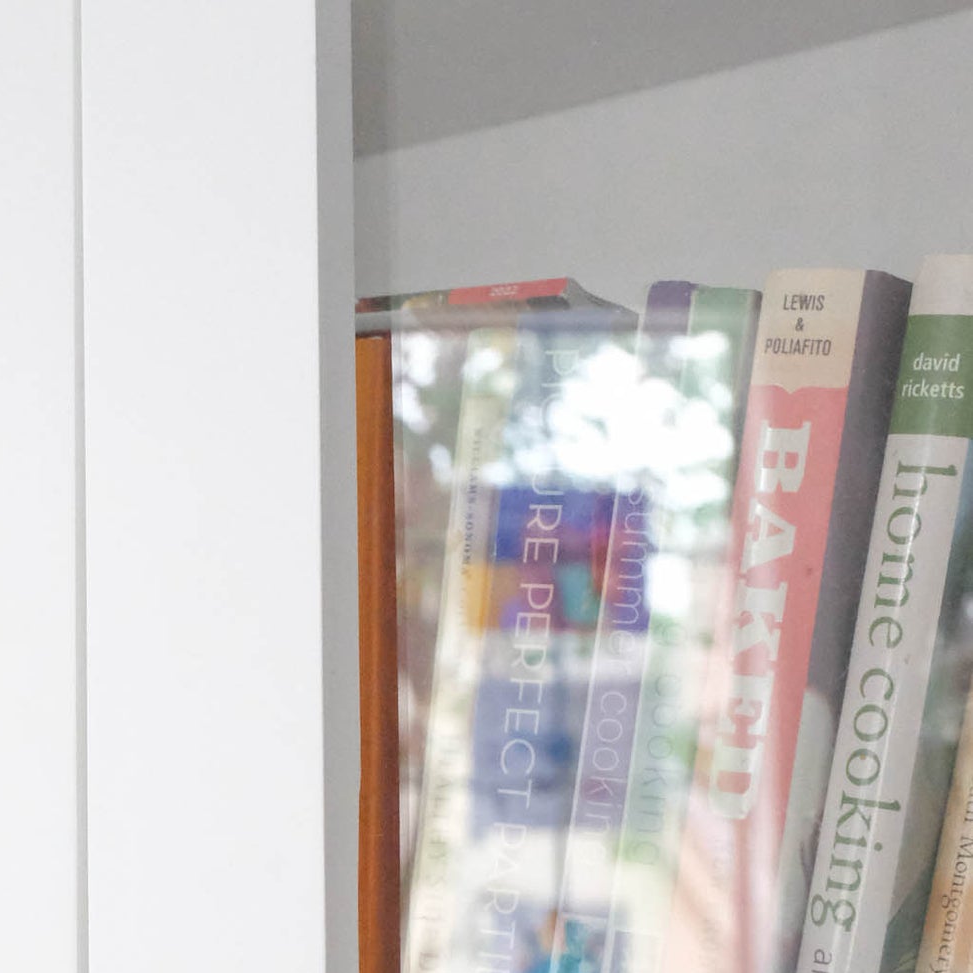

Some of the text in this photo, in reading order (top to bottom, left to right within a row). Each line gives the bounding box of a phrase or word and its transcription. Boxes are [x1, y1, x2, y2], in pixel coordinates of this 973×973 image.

[764, 338, 833, 357] POLIAFITO
[783, 294, 826, 312] LEWIS
[794, 317, 805, 332] &
[901, 379, 965, 400] ricketts
[912, 352, 961, 373] david
[521, 349, 580, 563] PICURE
[869, 460, 959, 650] home
[709, 420, 811, 820] BAKED
[496, 582, 555, 809] PERFECT
[810, 667, 901, 933] cooking
